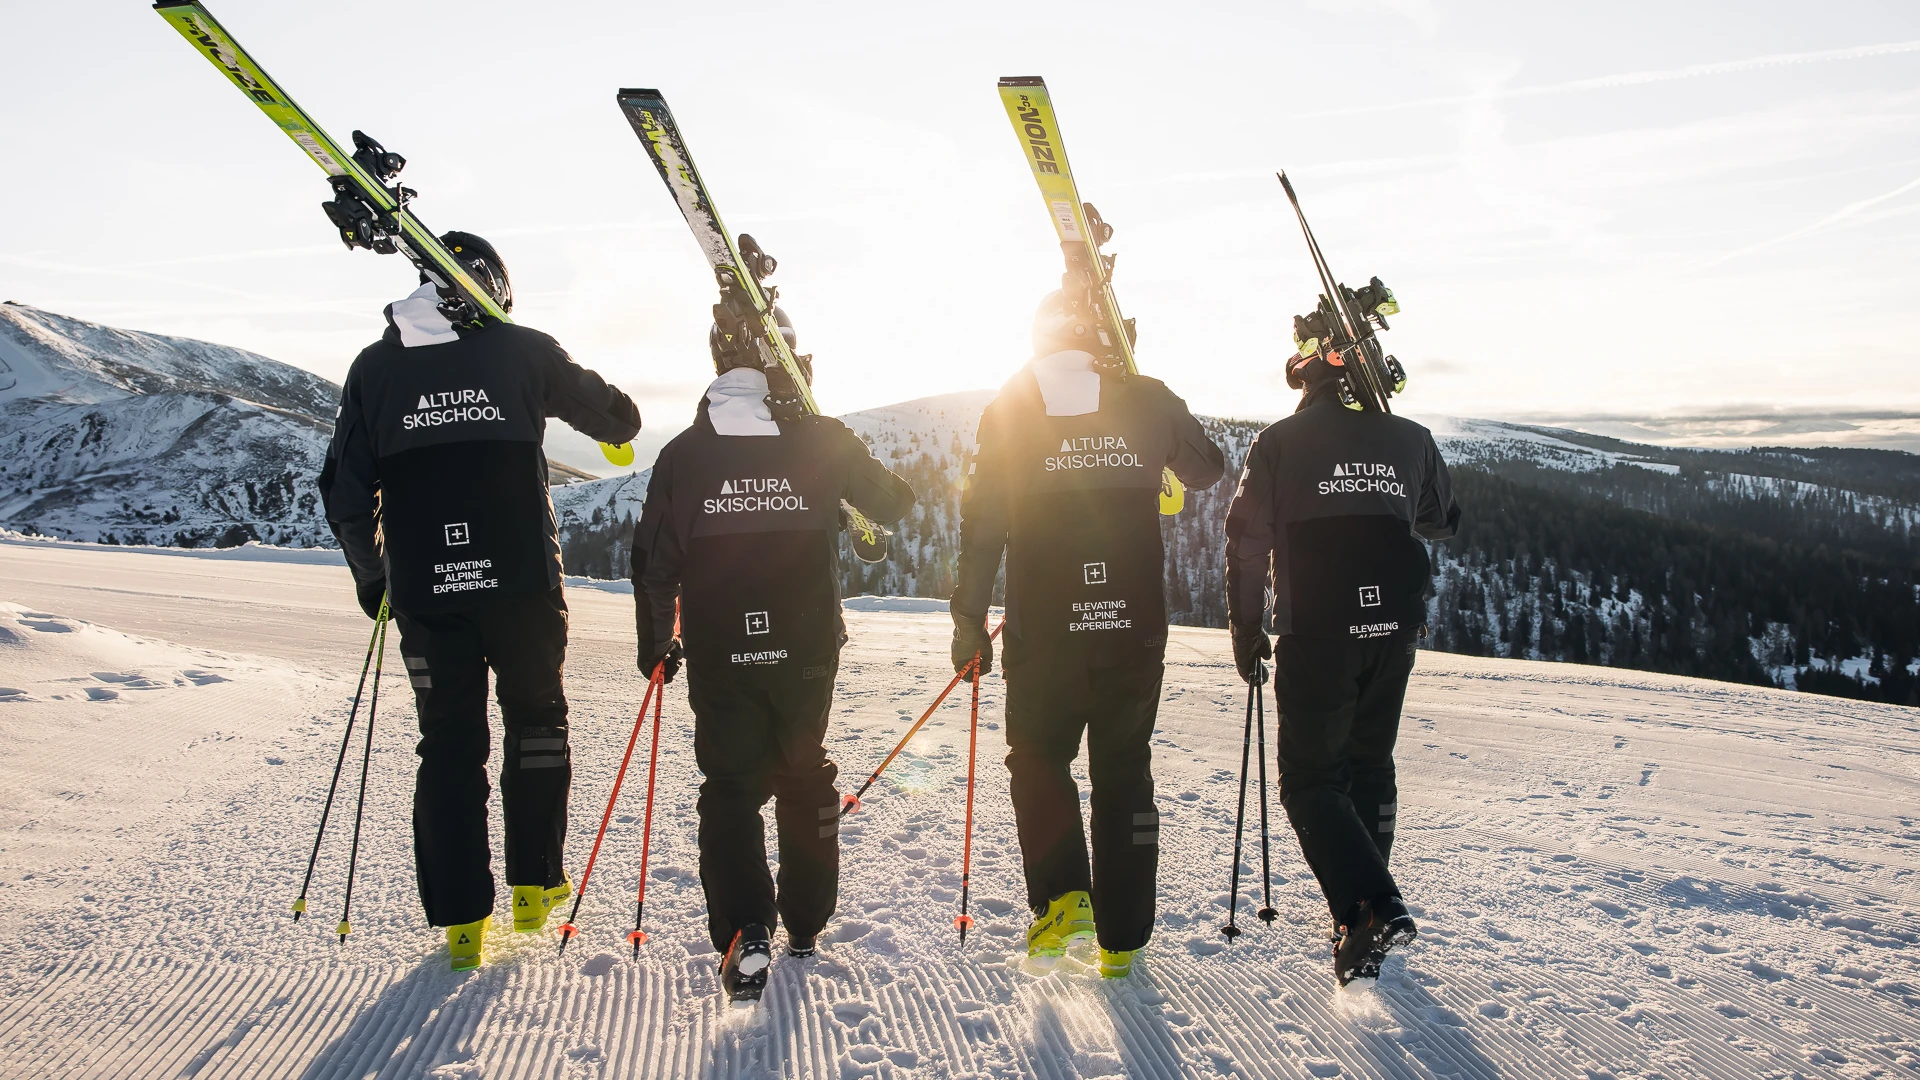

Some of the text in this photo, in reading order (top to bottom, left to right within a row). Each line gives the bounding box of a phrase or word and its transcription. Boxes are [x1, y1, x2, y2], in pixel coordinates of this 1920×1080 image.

[1017, 106, 1060, 176] NOIZE
[417, 388, 490, 410] ALTURA
[402, 406, 506, 431] SKISCHOOL
[1060, 436, 1128, 453] ALTURA
[1045, 453, 1144, 472] SKISCHOOL
[1333, 462, 1397, 479] ALTURA
[720, 478, 792, 495] ALTURA
[1318, 478, 1408, 498] SKISCHOOL
[703, 495, 809, 514] SKISCHOOL
[434, 559, 493, 574] ELEVATING
[444, 570, 484, 583] ALPINE
[433, 578, 499, 594] EXPERIENCE
[1072, 599, 1127, 612] ELEVATING
[1082, 610, 1119, 621] ALPINE
[1069, 619, 1132, 632] EXPERIENCE
[1349, 621, 1399, 634] ELEVATING
[731, 649, 788, 663] ELEVATING
